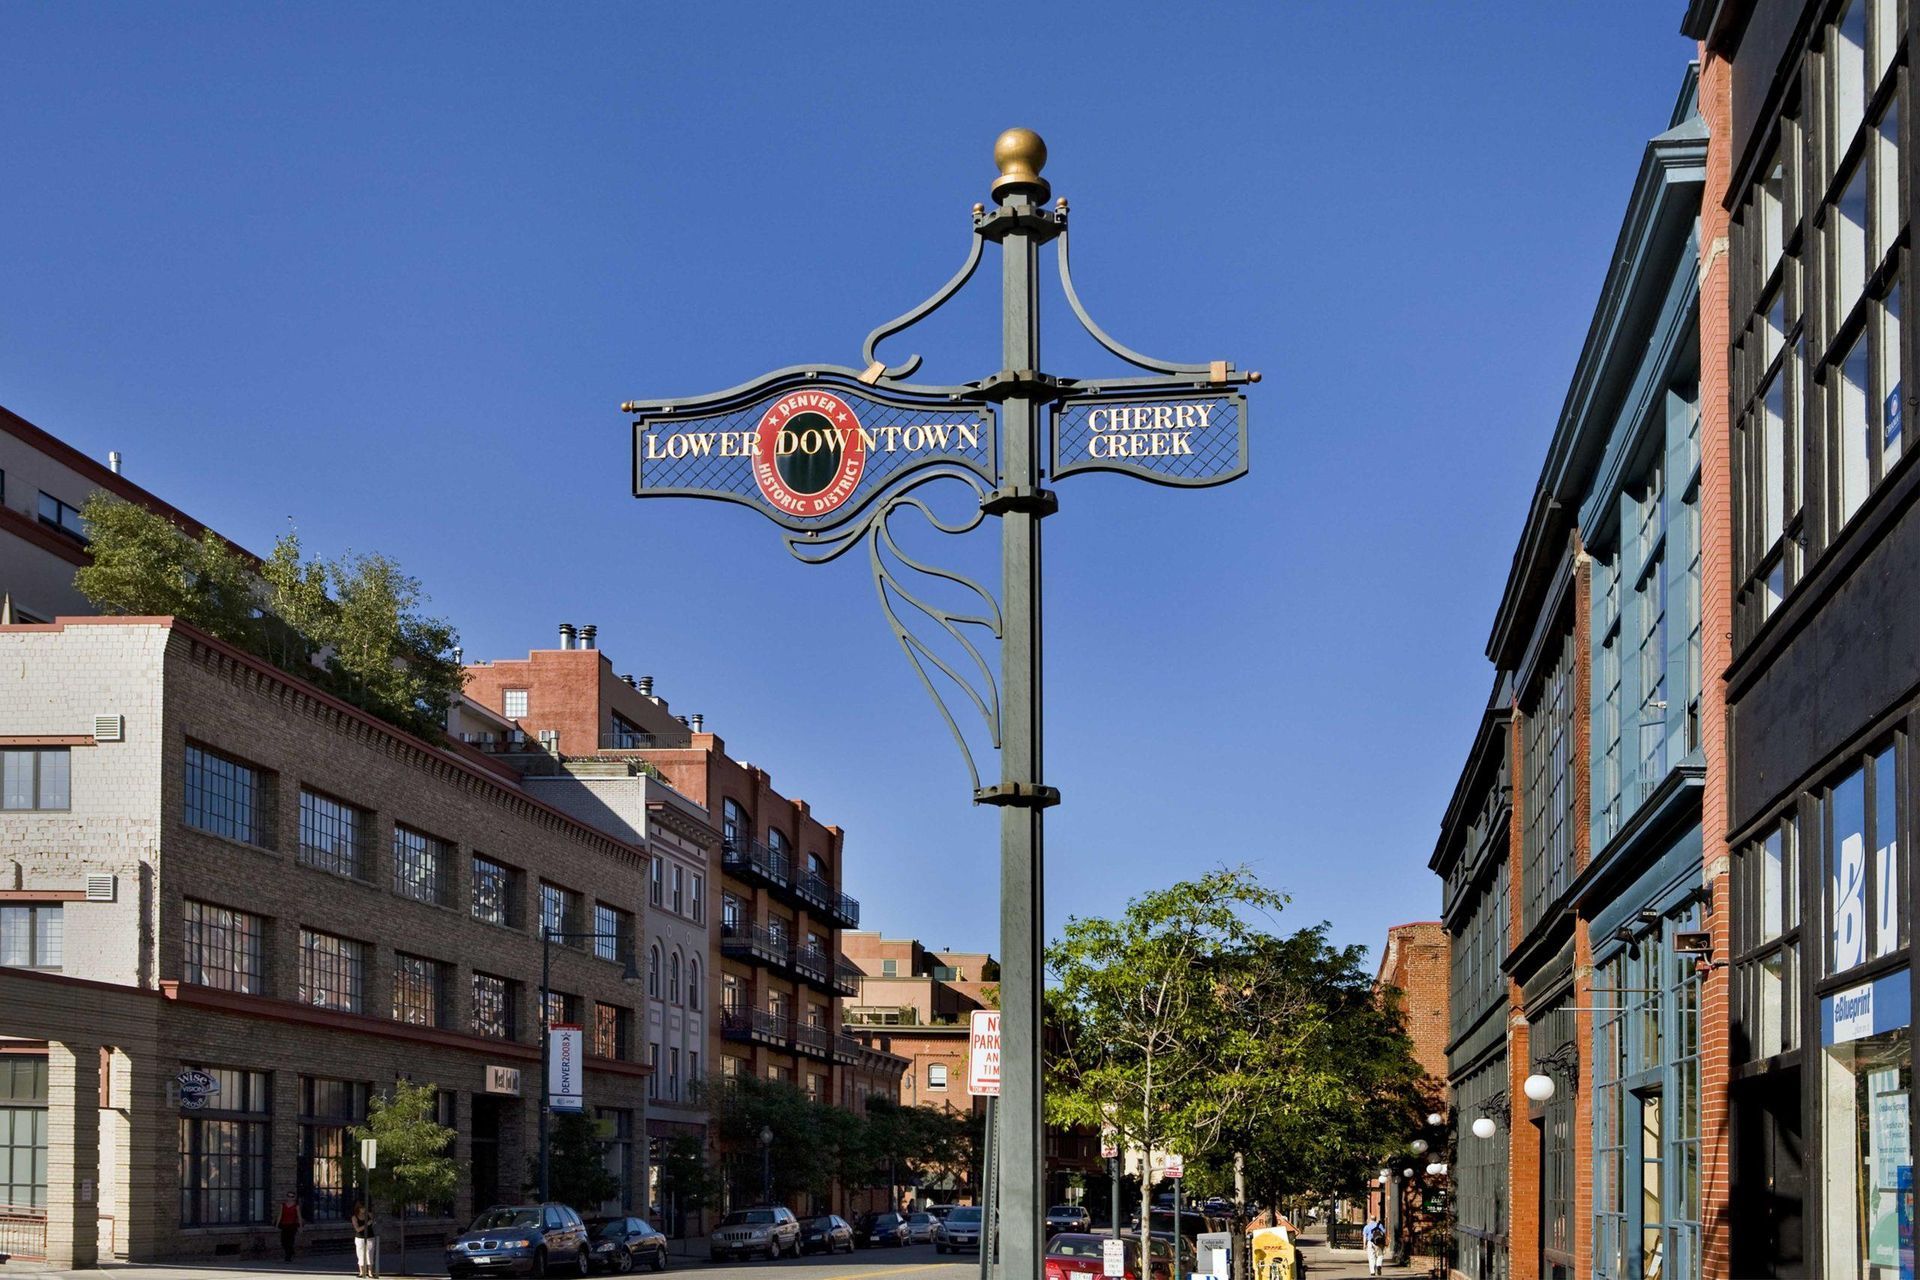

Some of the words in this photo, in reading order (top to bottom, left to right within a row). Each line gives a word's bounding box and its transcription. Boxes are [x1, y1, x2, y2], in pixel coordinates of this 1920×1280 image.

[777, 395, 837, 416] DENVER
[1088, 404, 1216, 432] CHERRY
[646, 432, 764, 459] LOWER
[776, 424, 981, 455] DOWNTOWN
[1088, 431, 1195, 458] CREEK
[758, 462, 807, 512] HISTORIC
[813, 458, 860, 511] DISTRICT
[1835, 988, 1871, 1023] eBlueprint
[988, 1017, 1000, 1032] N
[562, 1042, 571, 1093] DENVER2008
